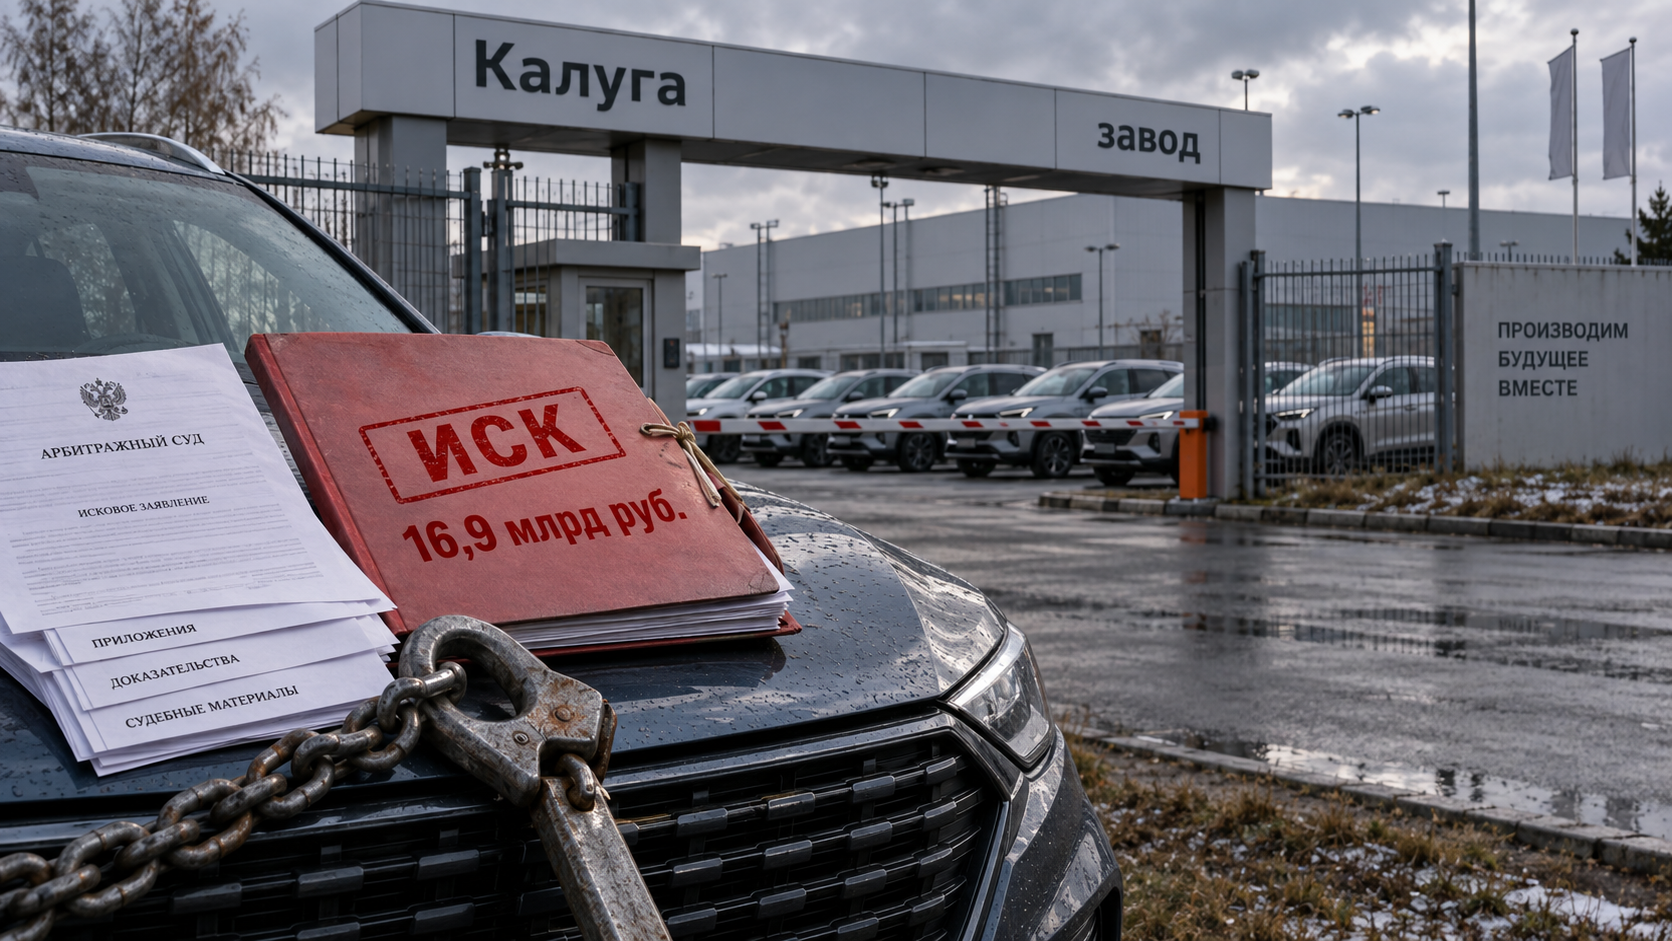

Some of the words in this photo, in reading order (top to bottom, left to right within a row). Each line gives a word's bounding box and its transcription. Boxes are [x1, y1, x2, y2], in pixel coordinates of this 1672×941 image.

[475, 39, 686, 112] Калуга
[1097, 122, 1201, 164] завод
[1498, 322, 1629, 342] ПРОИЗВОДИМ
[1498, 351, 1589, 370] БУДУЩЕЕ
[1499, 380, 1578, 396] ВМЕСТЕ
[41, 434, 168, 459] АРБИТРАЖНЫЙ
[171, 433, 205, 446] СУД
[406, 403, 587, 483] ИСК
[78, 504, 138, 518] ИСКОВОЕ
[139, 496, 210, 511] ЗАЯВЛЕНИЕ
[402, 514, 497, 562] 16,9
[504, 507, 611, 545] млрд
[608, 488, 688, 536] руб.
[91, 623, 197, 649] ПРИЛОЖЕНИЯ
[110, 654, 240, 690] ДОКАЗАТЕЛЬСТВА
[125, 704, 206, 729] СУДЕБНЫЕ
[207, 685, 299, 712] МАТЕРИАЛЫ
